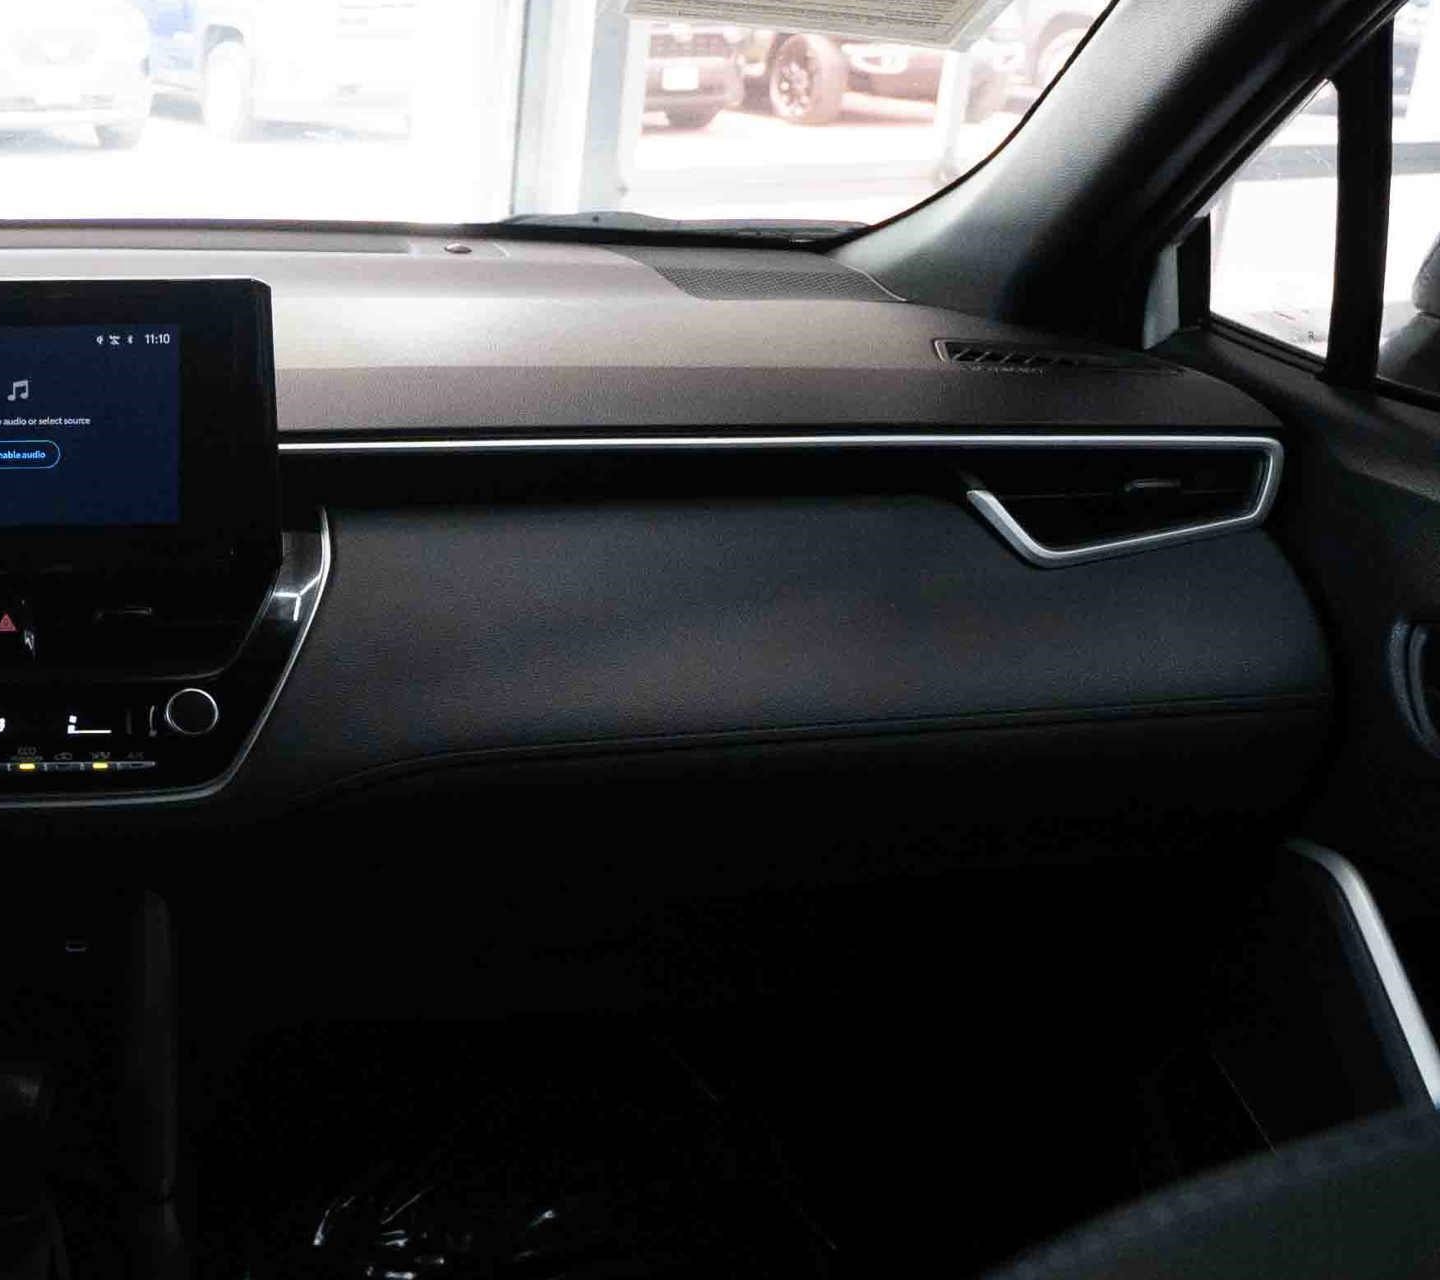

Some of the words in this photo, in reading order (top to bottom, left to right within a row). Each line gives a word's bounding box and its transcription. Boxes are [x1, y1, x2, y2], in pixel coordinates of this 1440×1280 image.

[144, 333, 171, 345] 11:10
[3, 416, 27, 426] audio
[38, 416, 63, 425] select
[21, 449, 46, 460] audio
